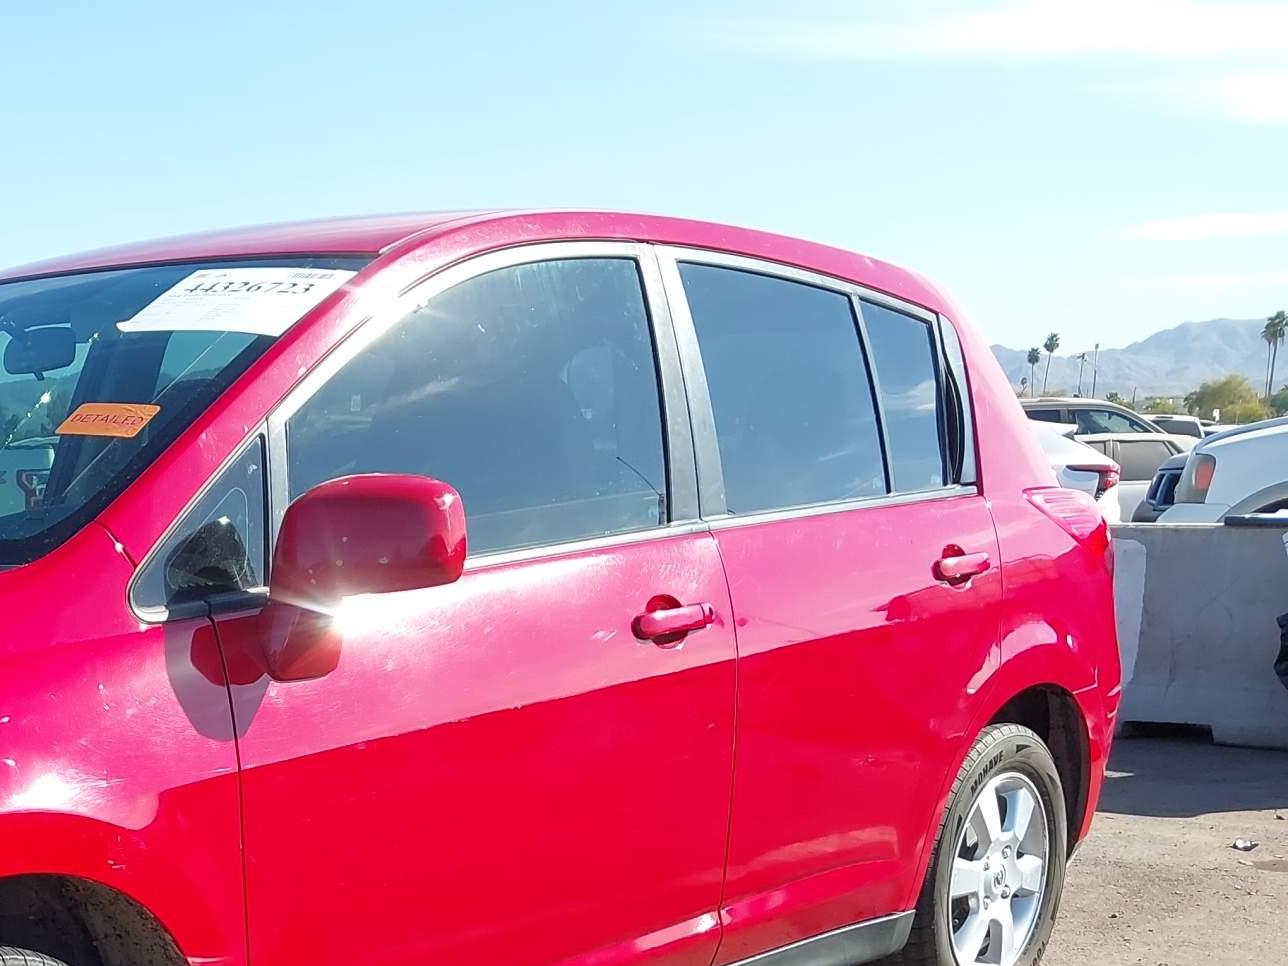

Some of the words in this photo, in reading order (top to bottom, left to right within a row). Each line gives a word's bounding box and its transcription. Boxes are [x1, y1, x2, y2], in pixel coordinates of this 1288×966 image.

[183, 281, 317, 295] 44326723
[70, 413, 145, 426] DETAILED
[969, 749, 1005, 798] MOHAVE
